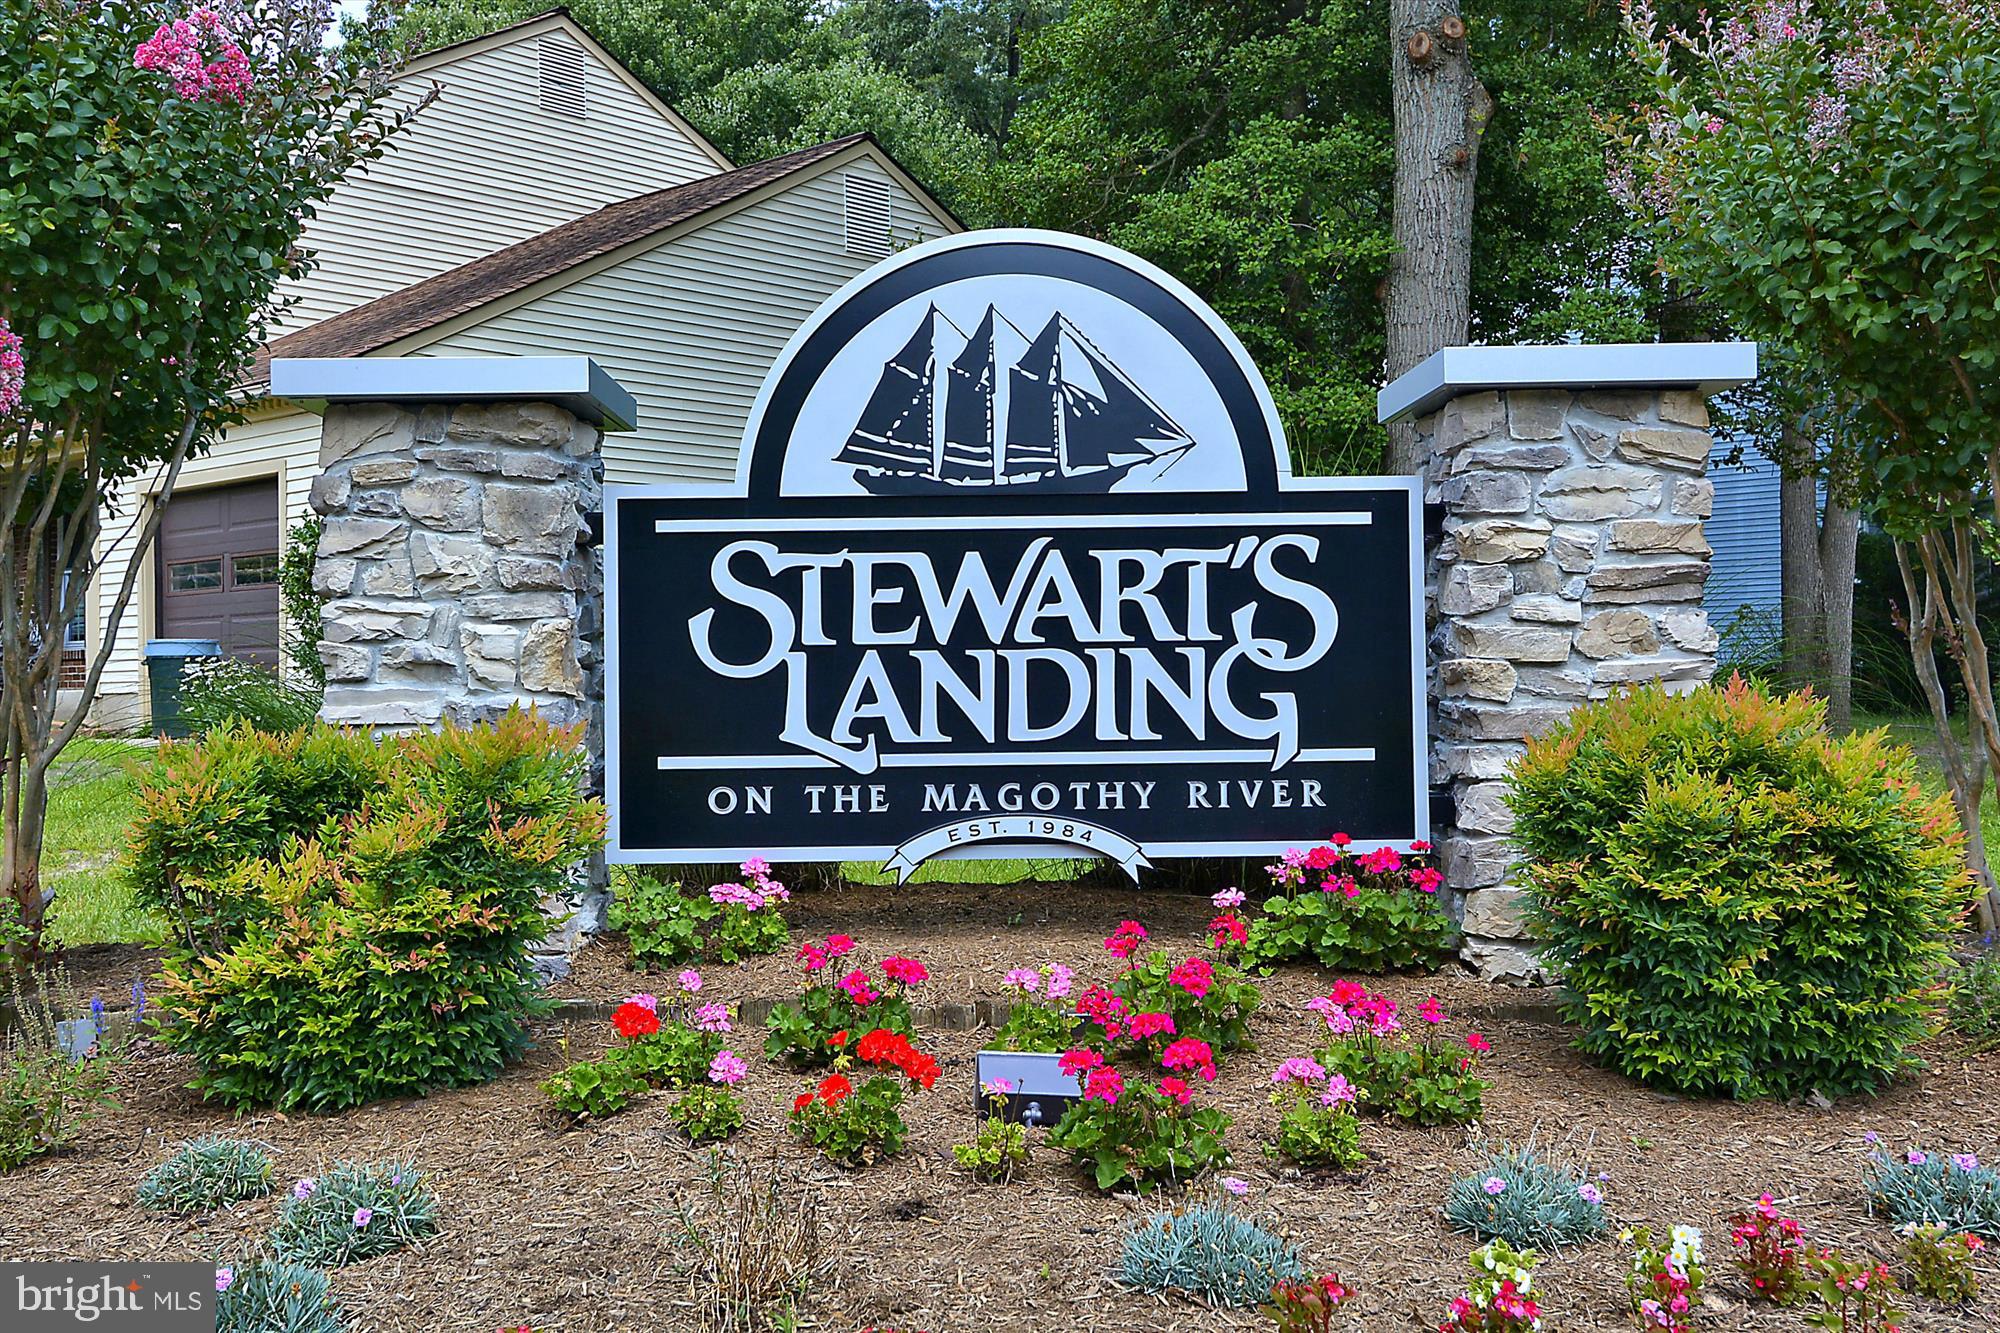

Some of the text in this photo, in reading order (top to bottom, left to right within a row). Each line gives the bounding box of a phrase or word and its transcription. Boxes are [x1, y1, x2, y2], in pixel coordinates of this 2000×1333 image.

[687, 534, 1340, 678] STEWART'S
[778, 638, 1301, 775] LANDING
[707, 779, 1328, 815] ON THE MAGOTHY RIVER
[948, 820, 1094, 844] EST. 1984
